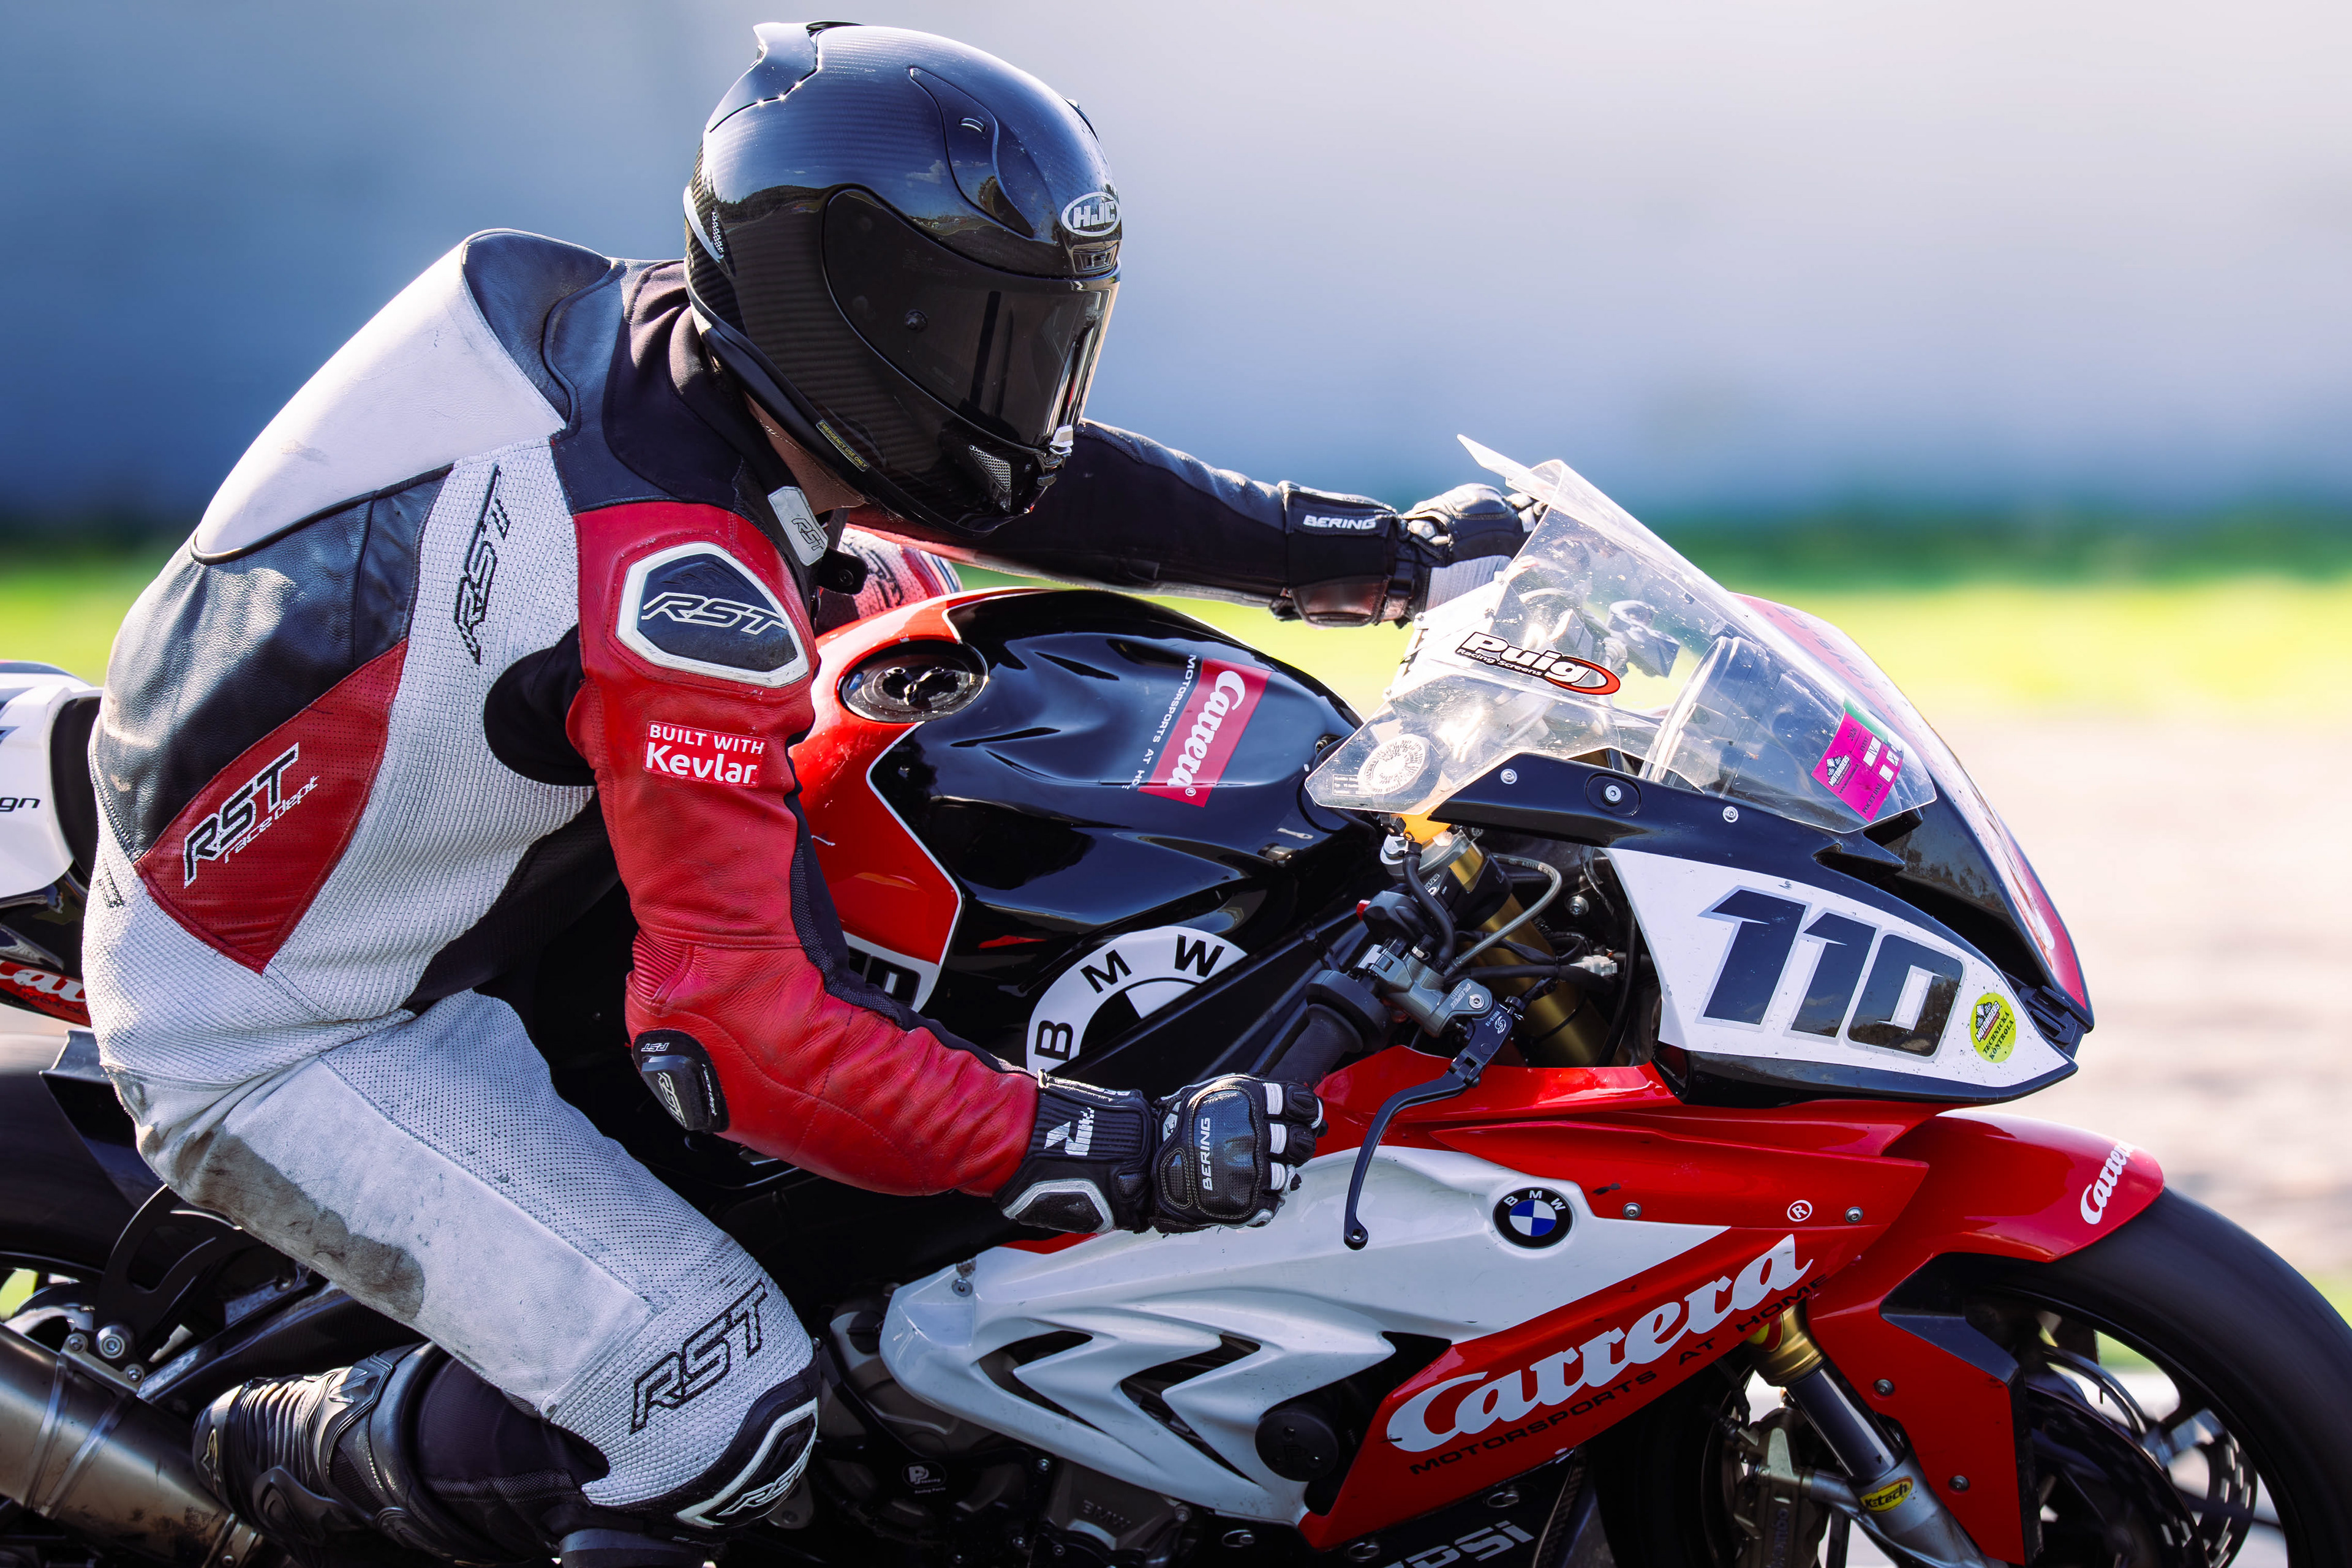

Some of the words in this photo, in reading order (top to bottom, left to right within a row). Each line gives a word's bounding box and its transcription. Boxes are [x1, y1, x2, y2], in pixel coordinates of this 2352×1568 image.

[1073, 201, 1115, 228] HJC
[819, 421, 846, 448] EMERGENCY
[845, 448, 856, 458] USE
[854, 456, 867, 467] ONLY
[791, 518, 826, 551] RST
[1303, 514, 1376, 530] BERING
[454, 462, 511, 666] RST
[641, 592, 788, 635] RST
[1457, 649, 1496, 664] Racing
[1498, 660, 1543, 676] Screens
[1460, 632, 1591, 682] Puig
[1153, 654, 1197, 743] MOTORSPORTS
[650, 725, 707, 746] BUILT
[714, 735, 764, 754] WITH
[1167, 671, 1246, 786] Carrera
[646, 742, 758, 784] Kevlar
[1143, 748, 1155, 764] AT
[1828, 755, 1850, 787] MOTORIDERS
[183, 742, 300, 889] RST
[225, 816, 273, 864] race
[274, 775, 320, 820] dept
[1034, 933, 1225, 1061] BMW
[1696, 885, 1967, 1063] 110
[1975, 1001, 2000, 1042] MOTORIDERS
[1989, 1020, 2014, 1060] KONTROLA
[641, 1042, 669, 1052] RST
[657, 1072, 687, 1128] RST
[1200, 1117, 1213, 1191] BERING
[1504, 1190, 1566, 1211] BMW
[629, 1278, 768, 1436] RST
[1386, 1234, 1814, 1452] Carrera
[1409, 1370, 1657, 1476] MOTORSPORTS
[1678, 1338, 1716, 1365] AT
[1736, 1273, 1828, 1333] HOME
